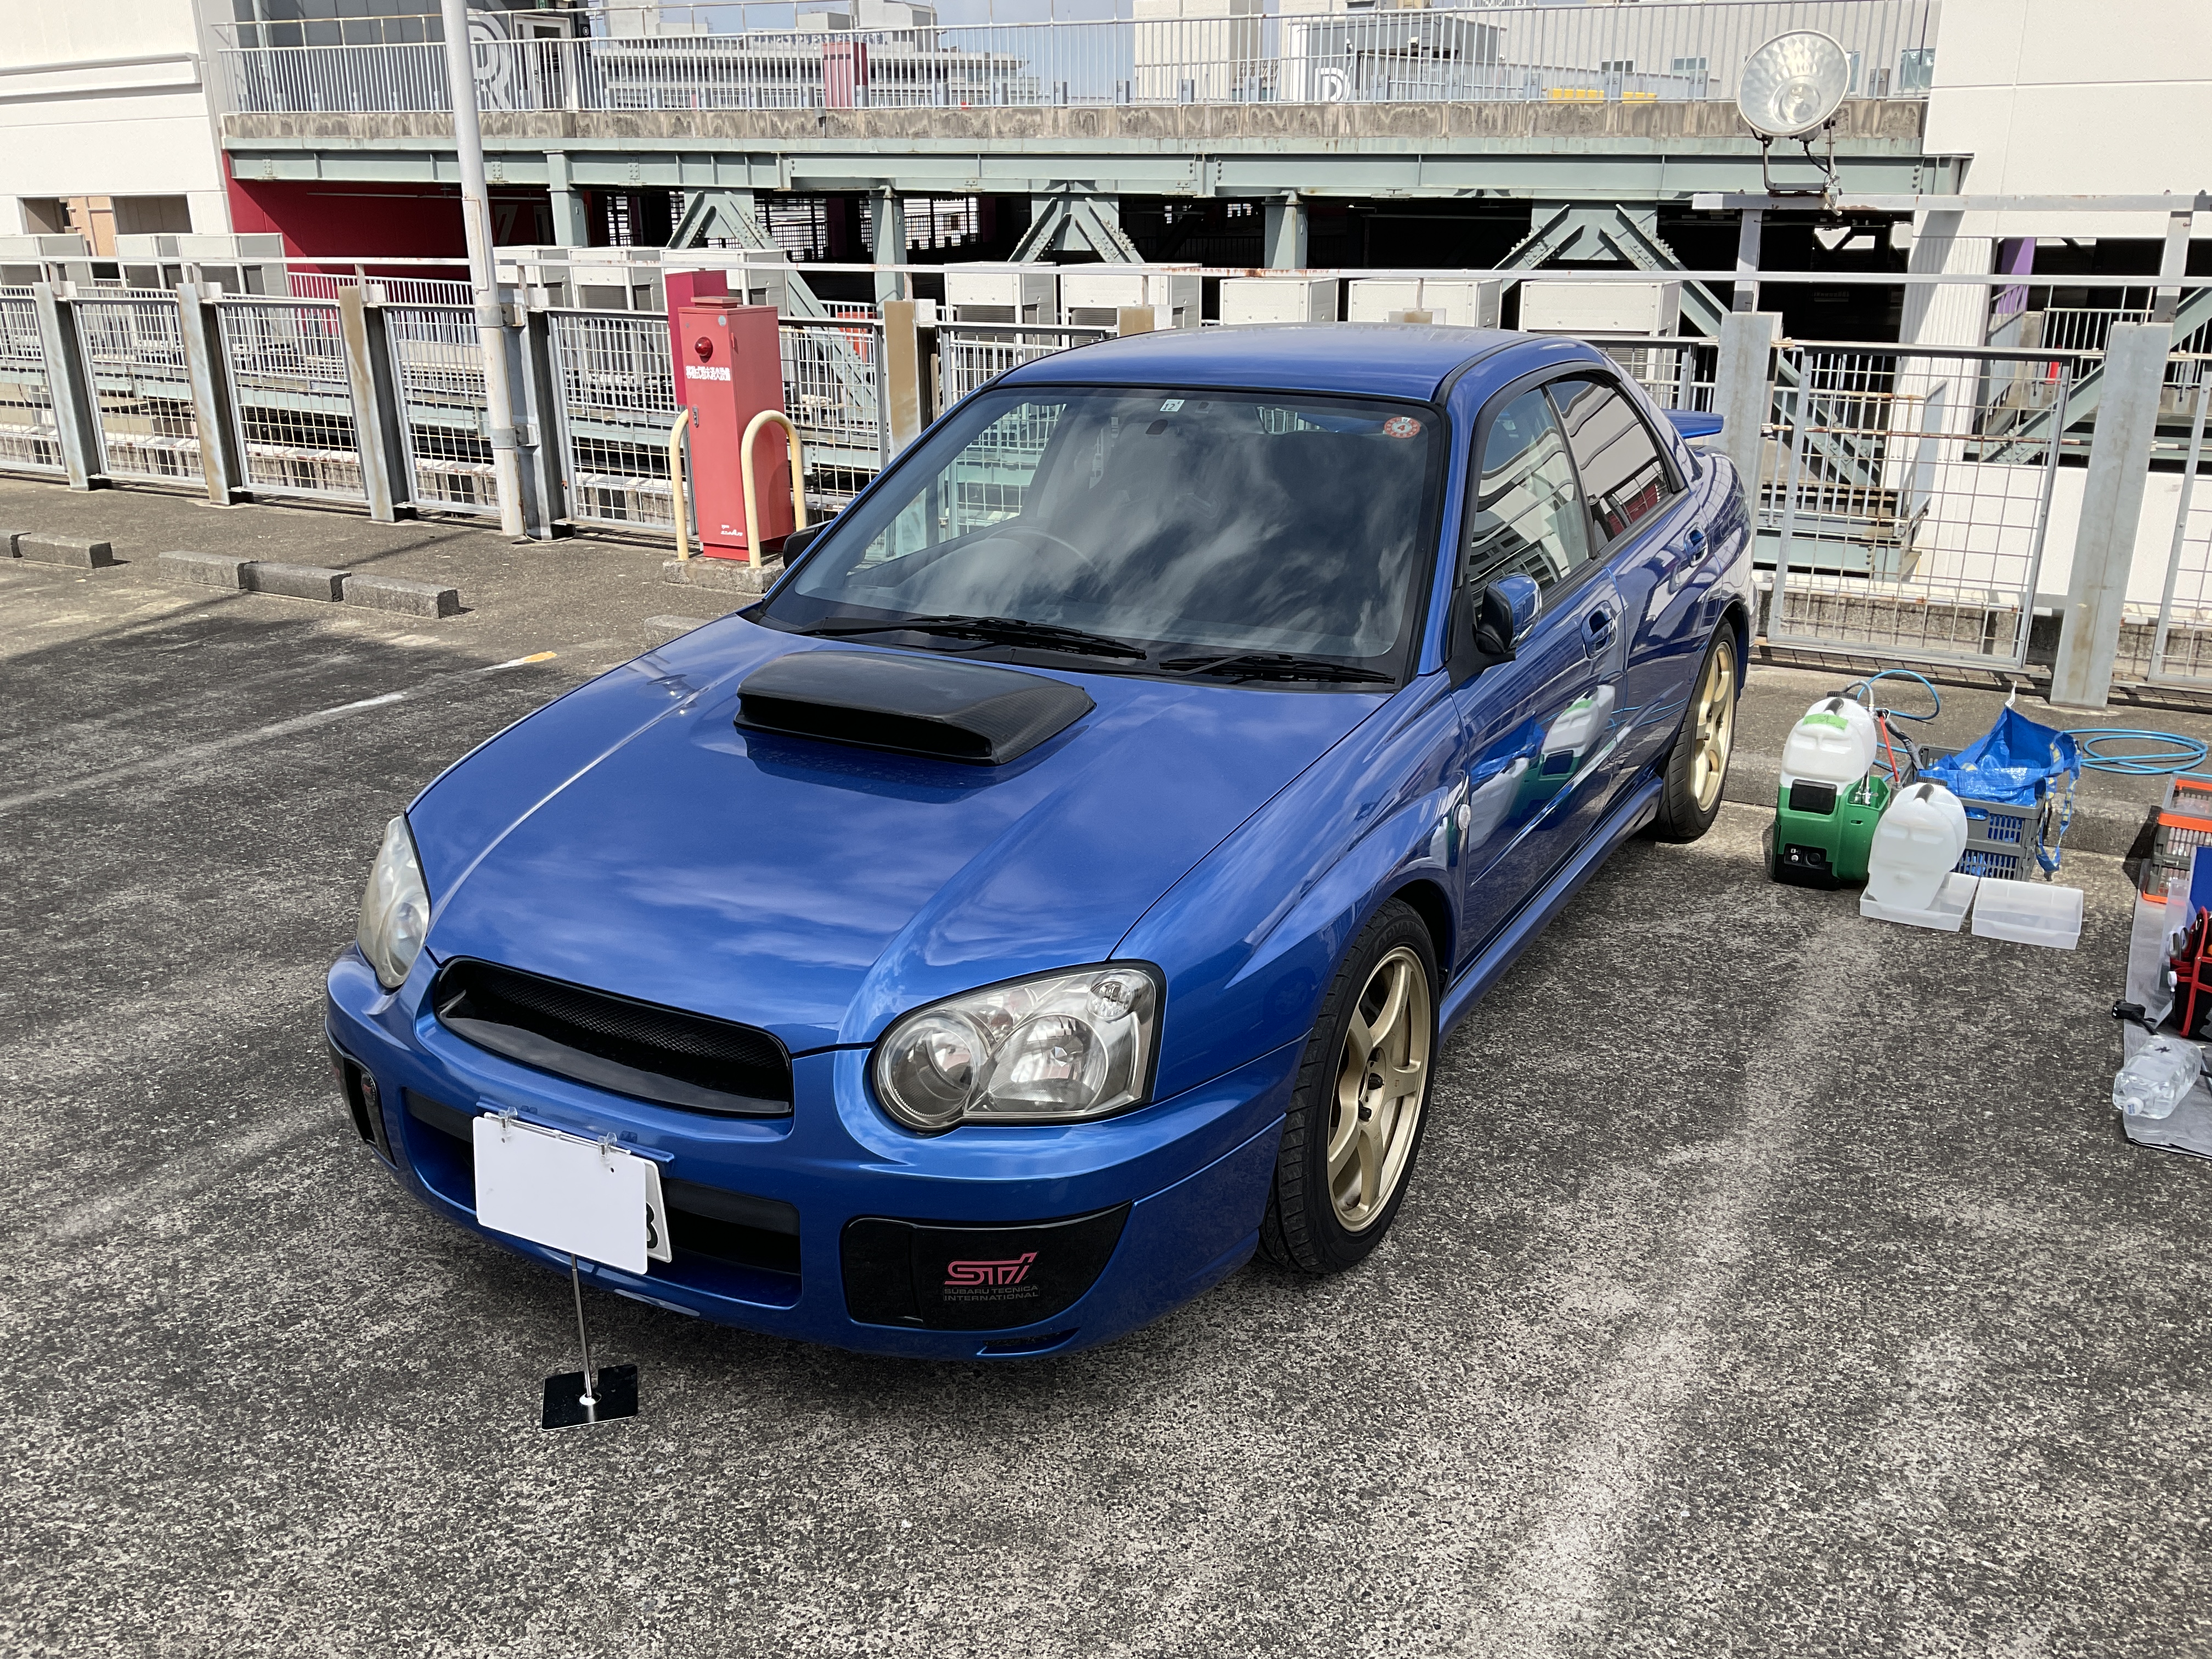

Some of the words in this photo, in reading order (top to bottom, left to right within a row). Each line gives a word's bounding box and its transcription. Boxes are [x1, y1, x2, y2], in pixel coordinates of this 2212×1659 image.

[1378, 921, 1417, 948] ADVAN
[991, 1285, 1039, 1294] TECNICA
[944, 1292, 1039, 1301] INTERNATIONAL
